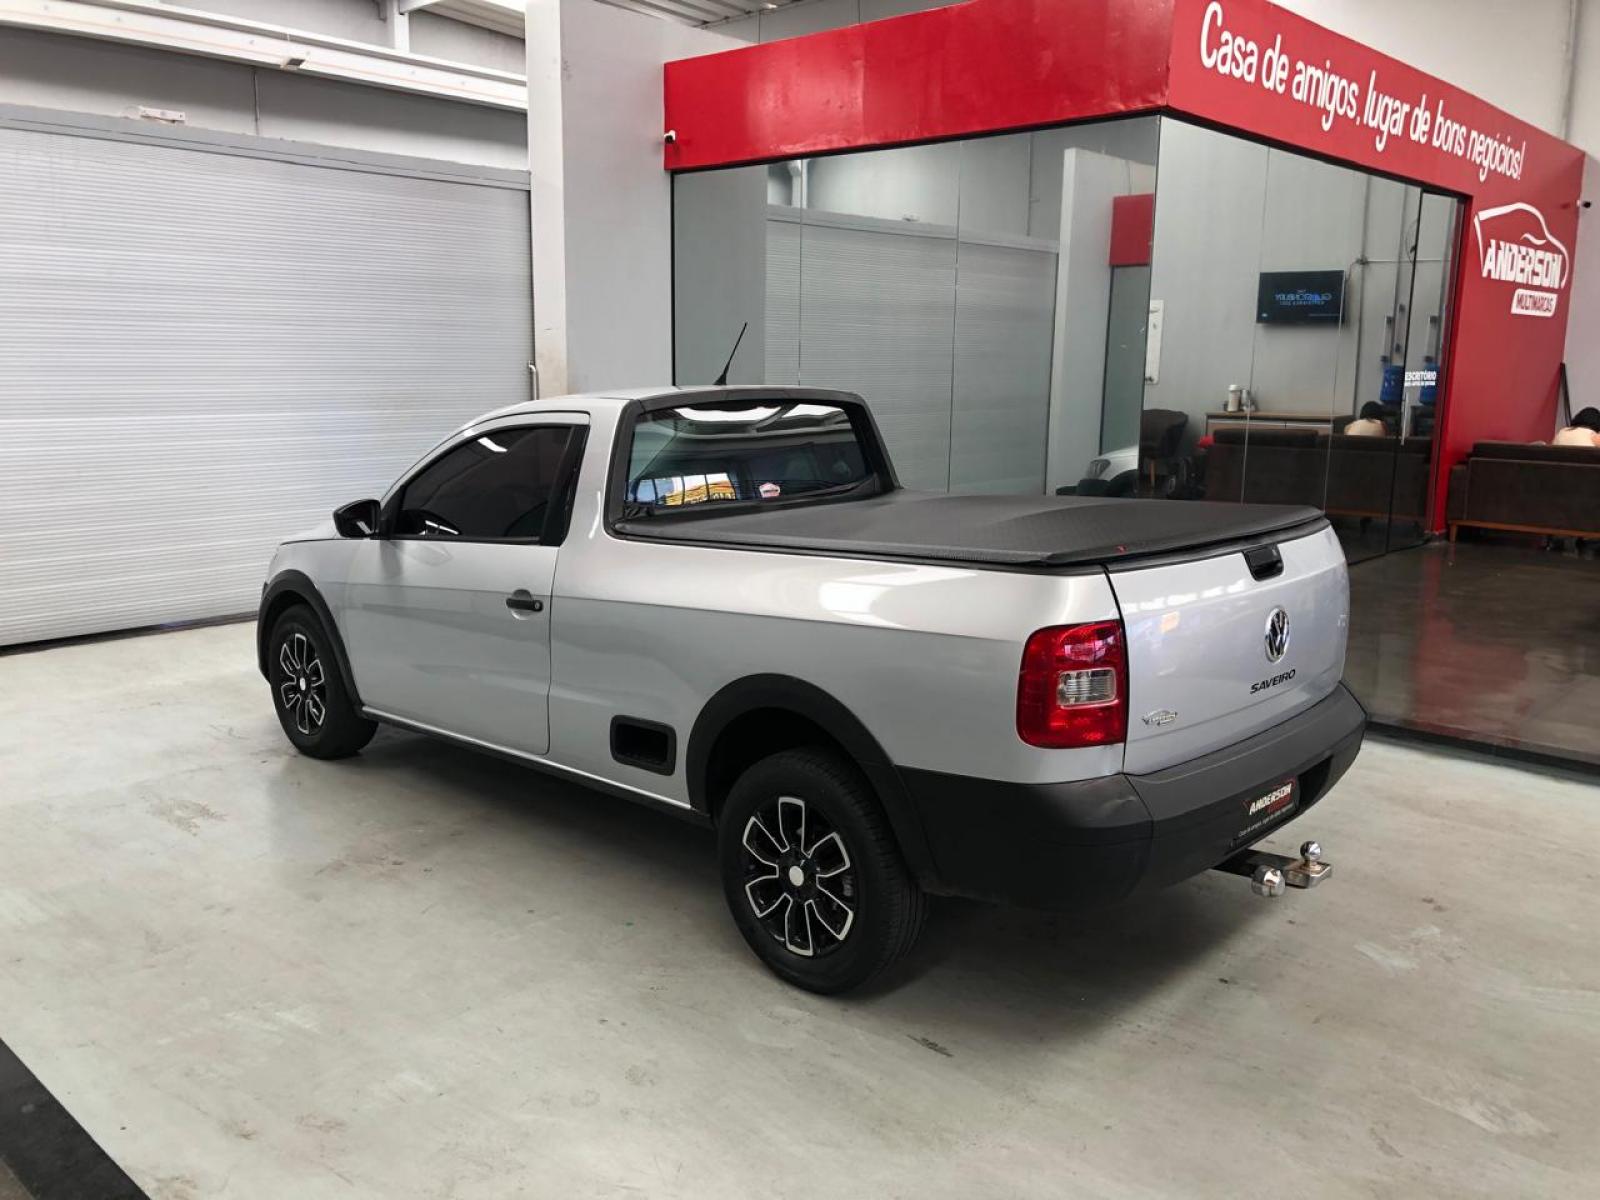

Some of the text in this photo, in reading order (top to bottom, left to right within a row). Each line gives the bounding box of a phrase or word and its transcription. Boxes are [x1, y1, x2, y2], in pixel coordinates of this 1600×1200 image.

[1200, 1, 1526, 183] Casa de amigos, lugar de bons negócios!
[1482, 239, 1563, 290] ANDERSON
[1516, 293, 1554, 312] MULTIMARCAS
[1250, 669, 1296, 694] SAVEIRO
[1249, 783, 1292, 815] ANDERSON
